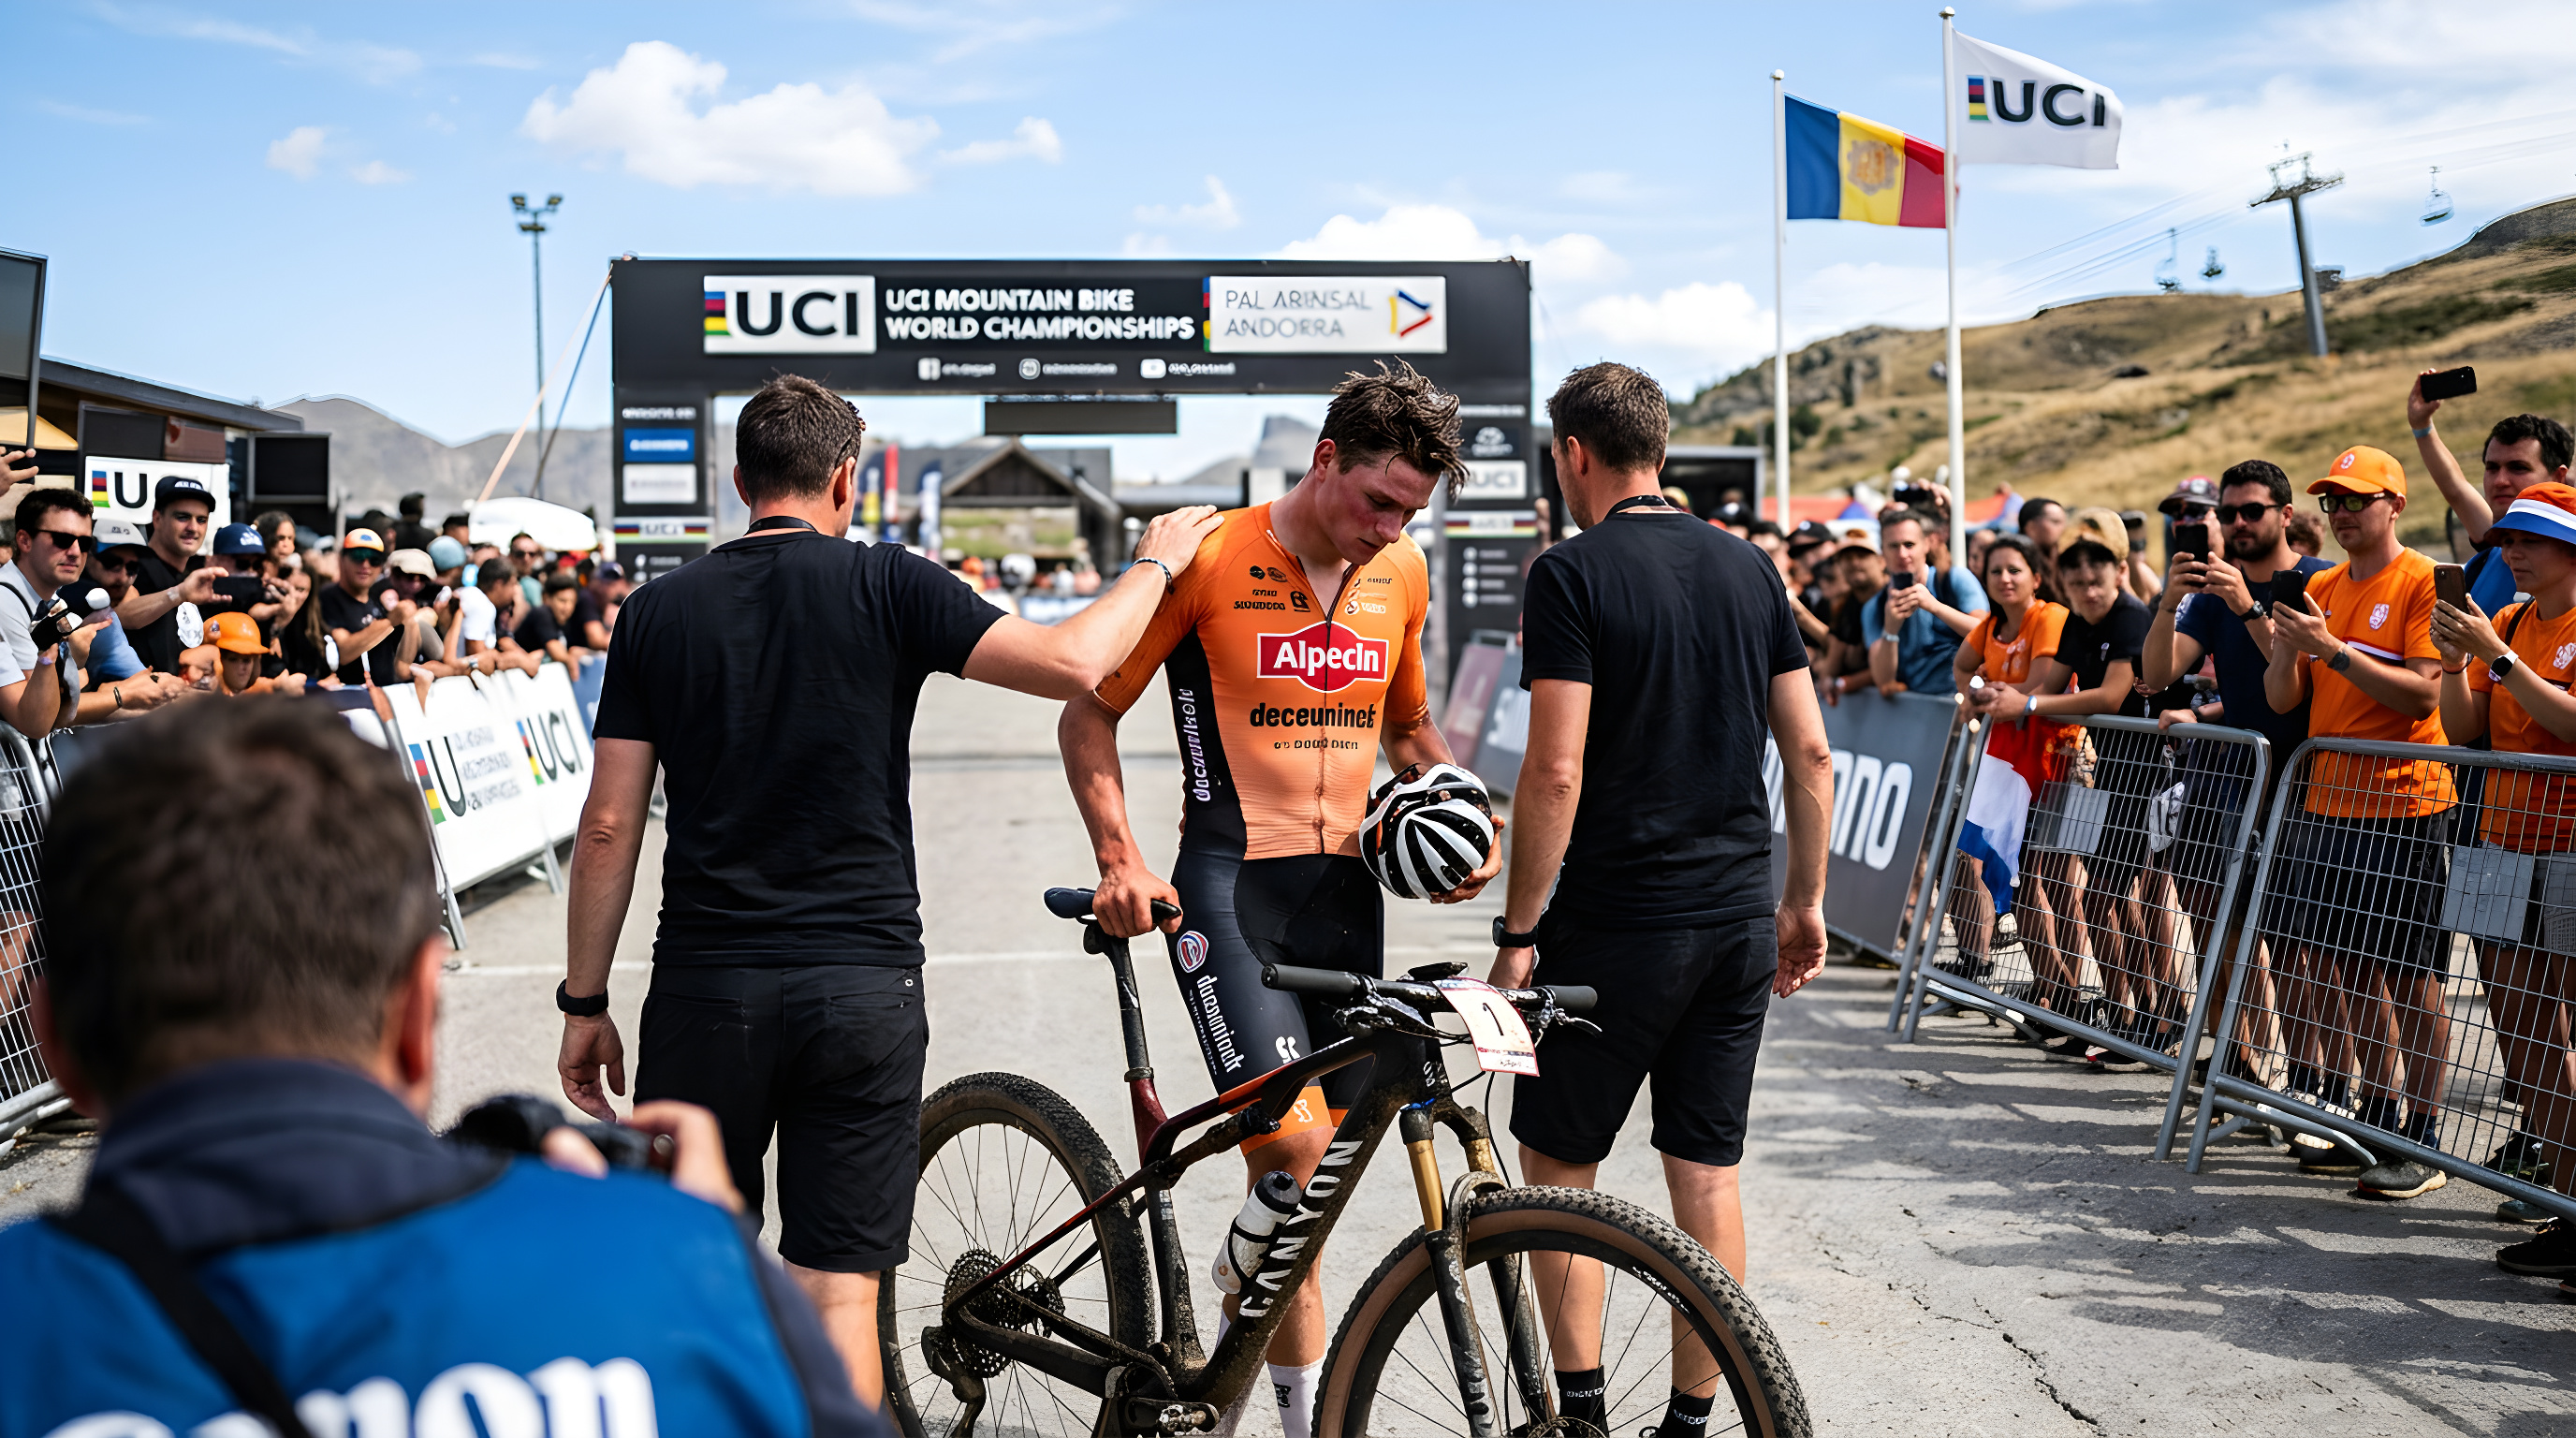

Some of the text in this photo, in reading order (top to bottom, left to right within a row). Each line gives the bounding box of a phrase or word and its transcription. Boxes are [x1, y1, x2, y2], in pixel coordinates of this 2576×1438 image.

[1993, 81, 2105, 126] UCI
[736, 291, 858, 336] UCI
[886, 288, 1134, 312] UCI MOUNTAIN BIKE
[1226, 290, 1265, 310] PAL
[885, 315, 1195, 340] WORLD CHAMPIONSHIPS
[527, 709, 584, 782] UCI
[1238, 1140, 1363, 1318] CANYON
